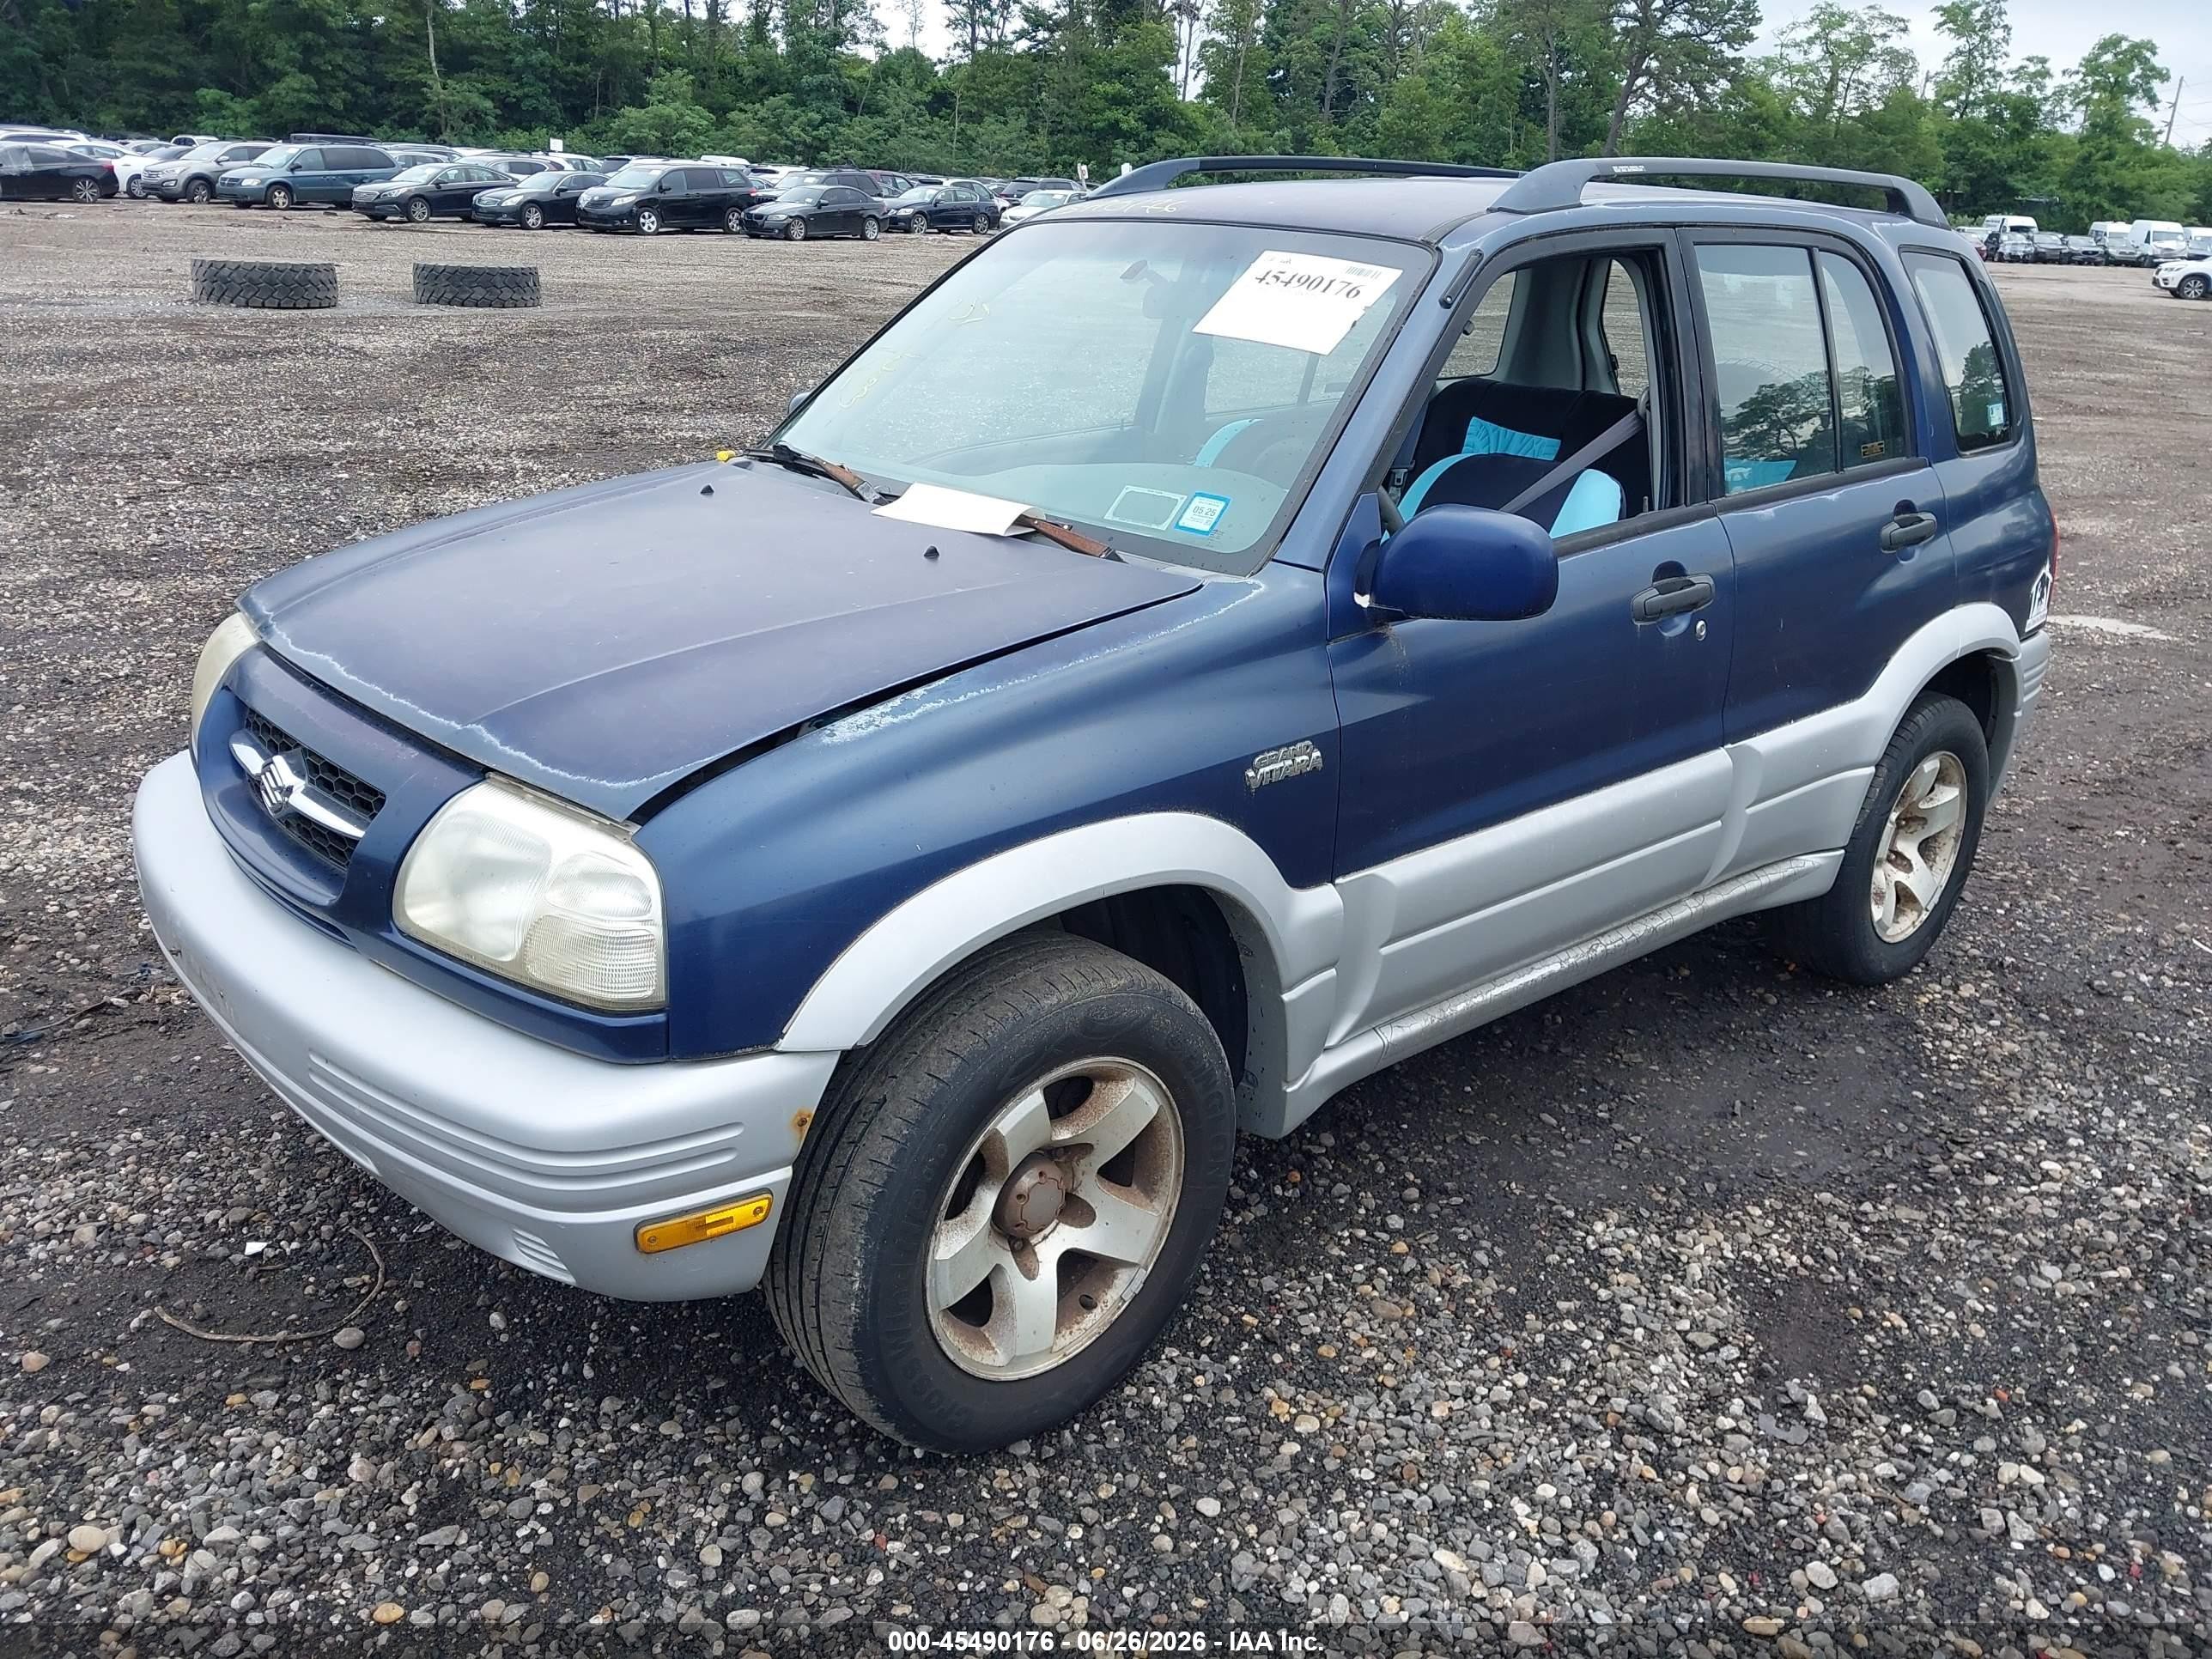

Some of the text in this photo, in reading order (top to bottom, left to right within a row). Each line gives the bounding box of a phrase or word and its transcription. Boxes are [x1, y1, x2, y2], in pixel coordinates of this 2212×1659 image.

[1255, 270, 1366, 299] 45490176
[1244, 748, 1323, 788] VITARA
[1253, 740, 1313, 768] GRAND
